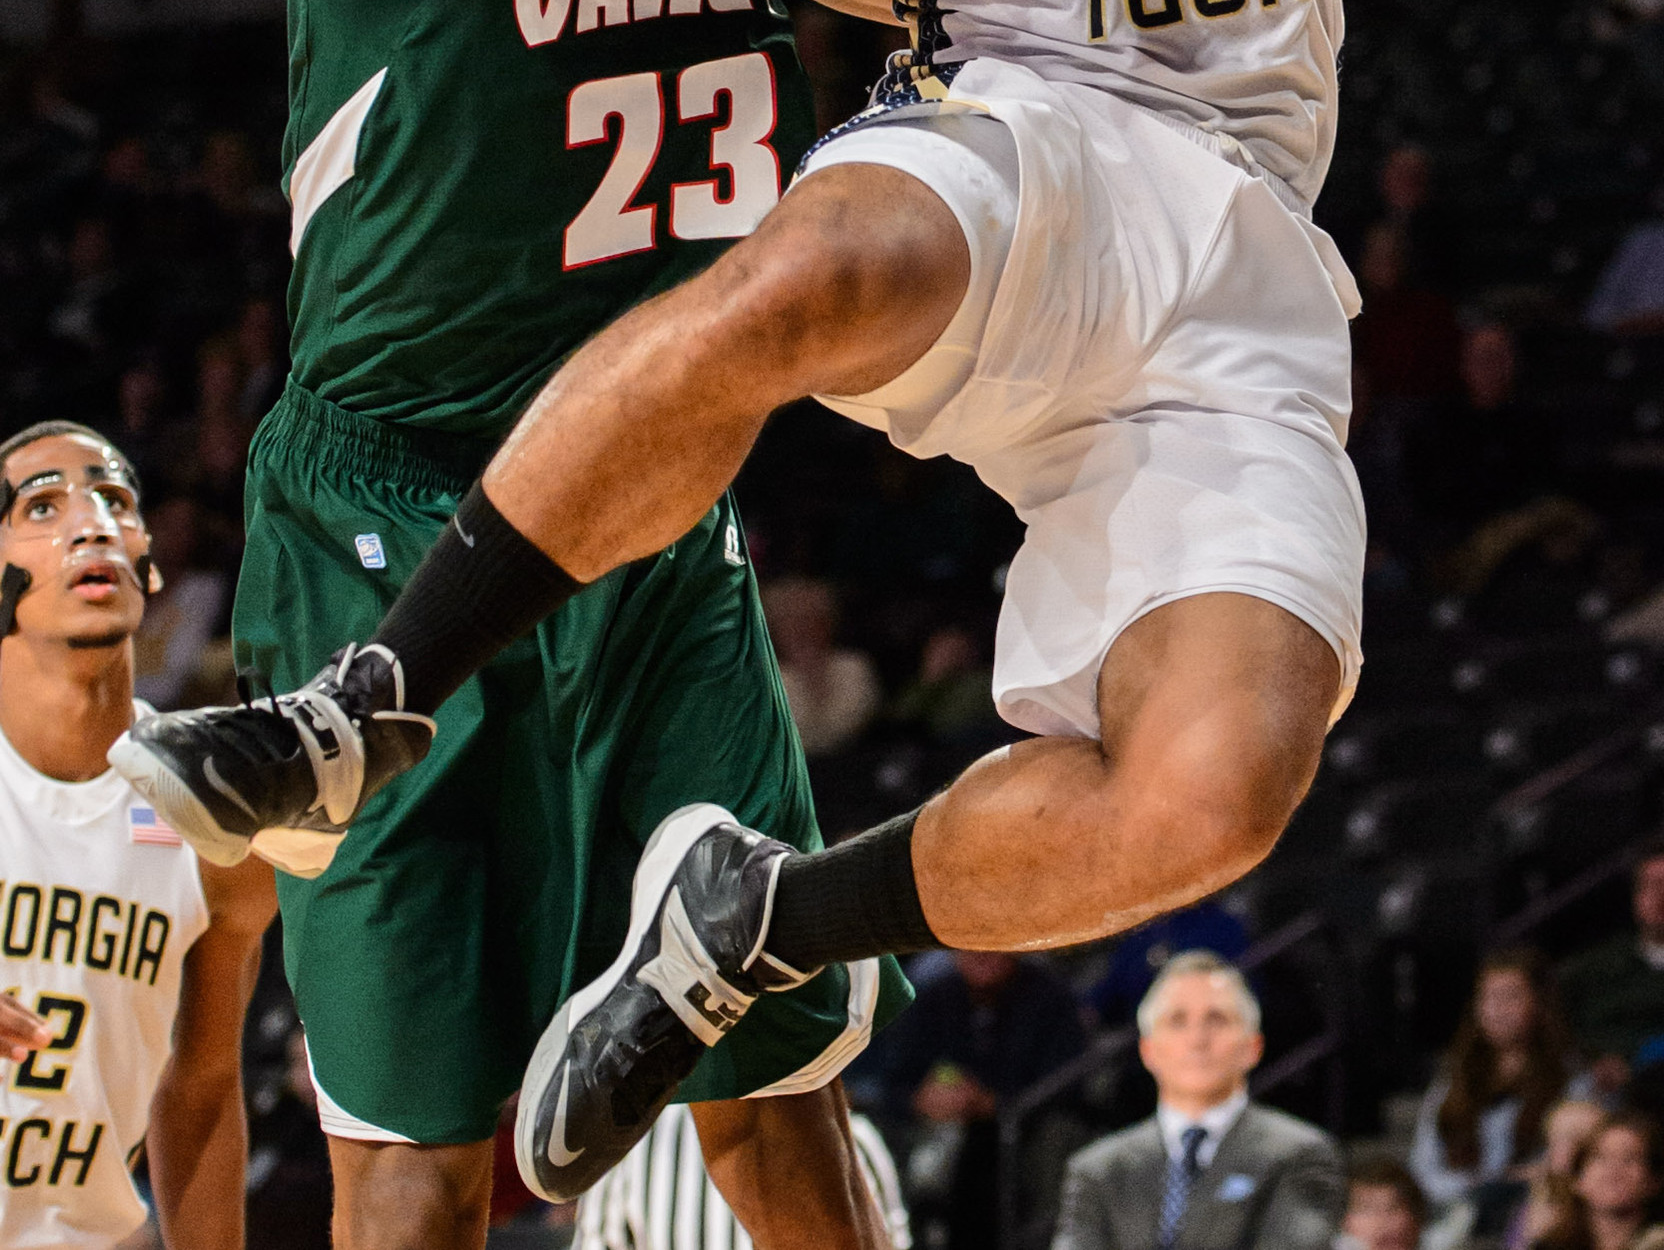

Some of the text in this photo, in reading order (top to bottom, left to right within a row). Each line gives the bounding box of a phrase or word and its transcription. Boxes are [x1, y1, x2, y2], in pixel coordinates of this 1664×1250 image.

[562, 51, 781, 271] 23
[0, 878, 172, 987] ORGIA
[0, 986, 90, 1093] 2
[0, 1117, 105, 1188] CH
